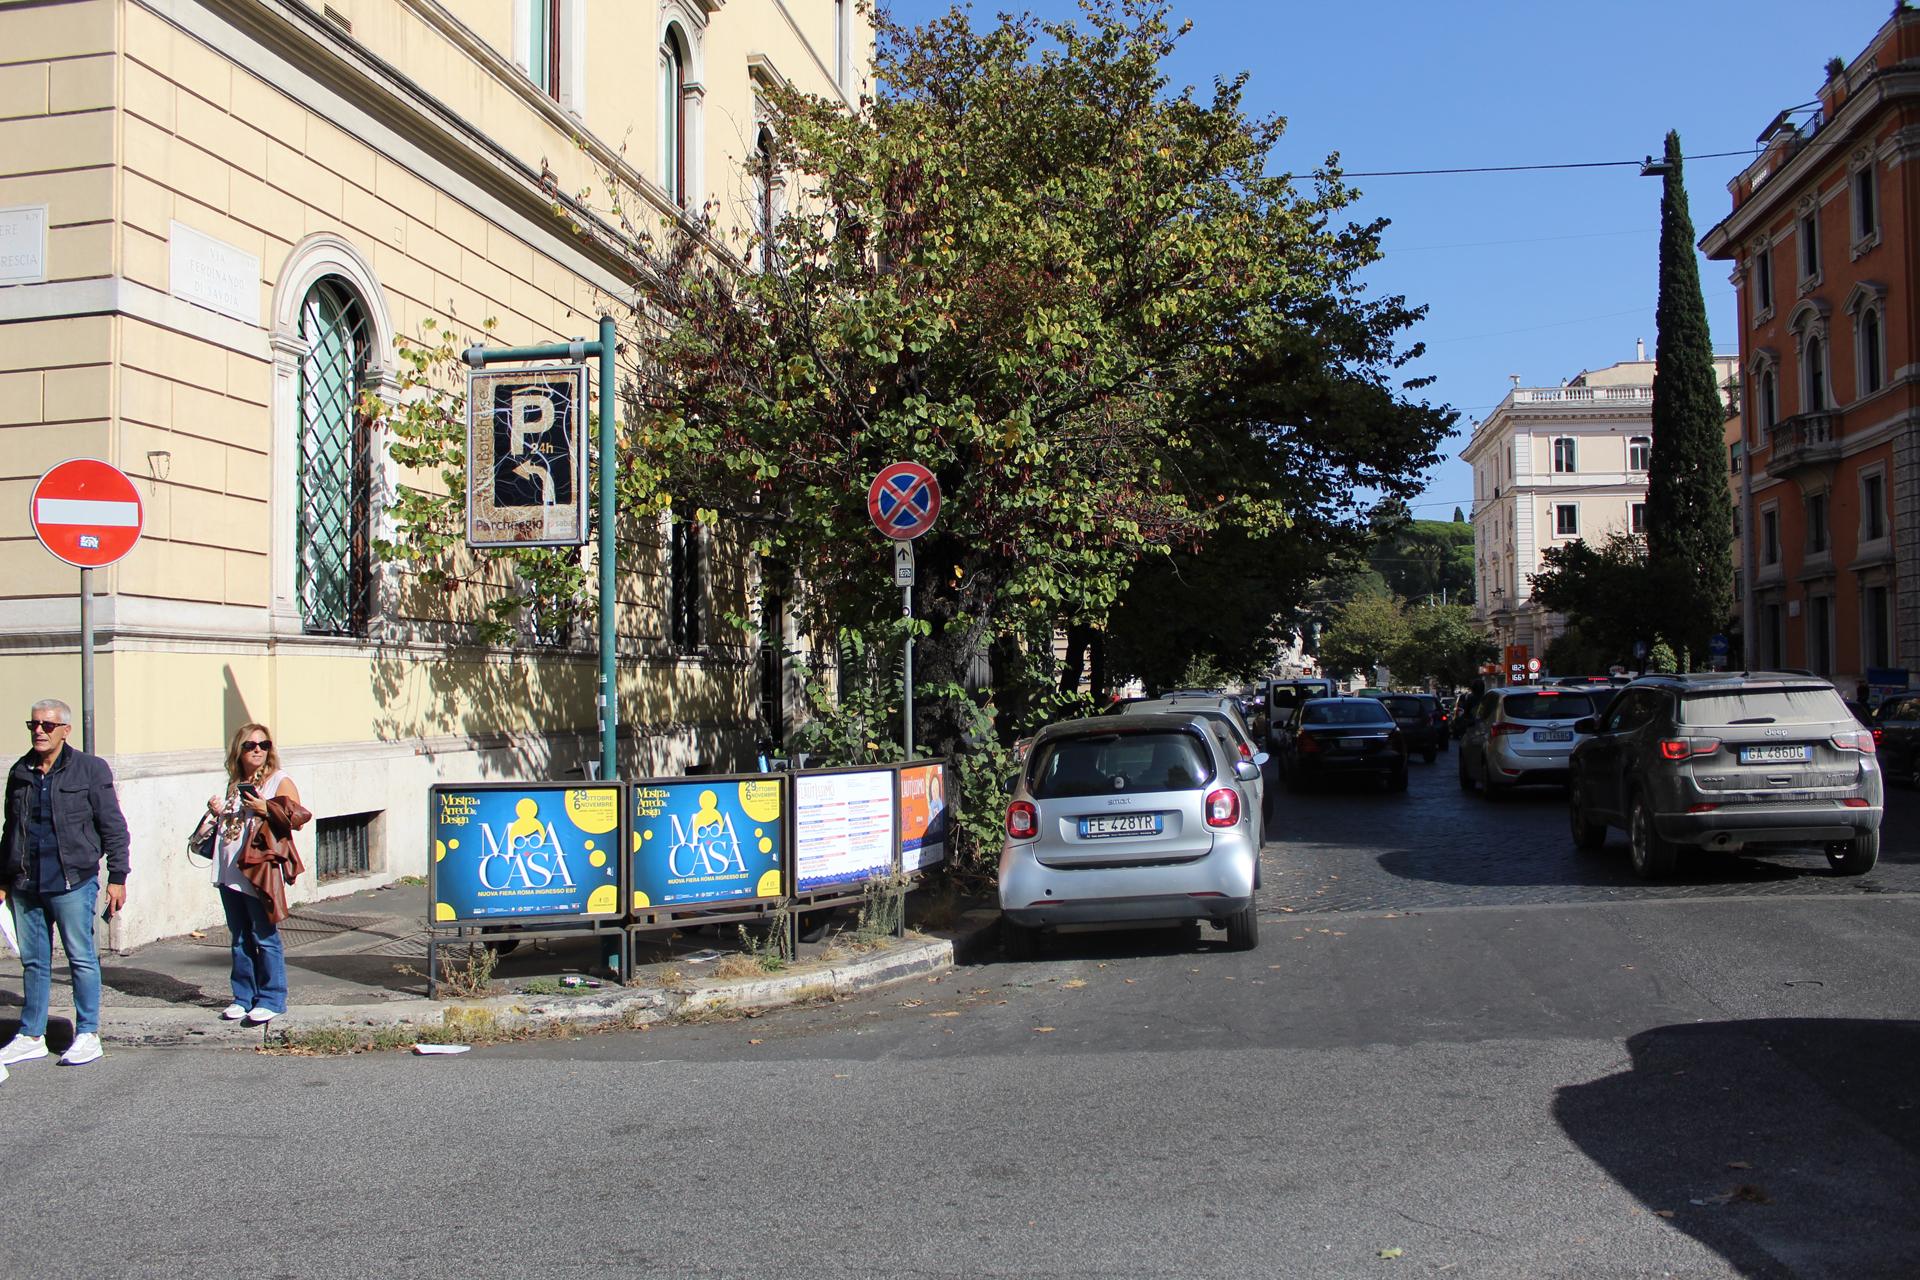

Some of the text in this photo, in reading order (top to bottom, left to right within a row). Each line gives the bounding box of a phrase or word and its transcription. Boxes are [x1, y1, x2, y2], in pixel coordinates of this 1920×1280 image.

[511, 394, 555, 456] P
[530, 442, 554, 455] 24h
[1765, 728, 1788, 737] Jeep
[1748, 747, 1763, 760] GA
[1767, 745, 1804, 758] 486DG
[745, 781, 757, 791] 29
[573, 789, 587, 801] 29
[745, 791, 752, 801] 6
[573, 800, 581, 811] 6
[1107, 797, 1132, 806] smart
[440, 814, 470, 826] Design
[1088, 817, 1106, 833] FE
[1110, 814, 1153, 831] 428YR
[668, 840, 750, 878] CASA
[479, 851, 577, 890] CASA
